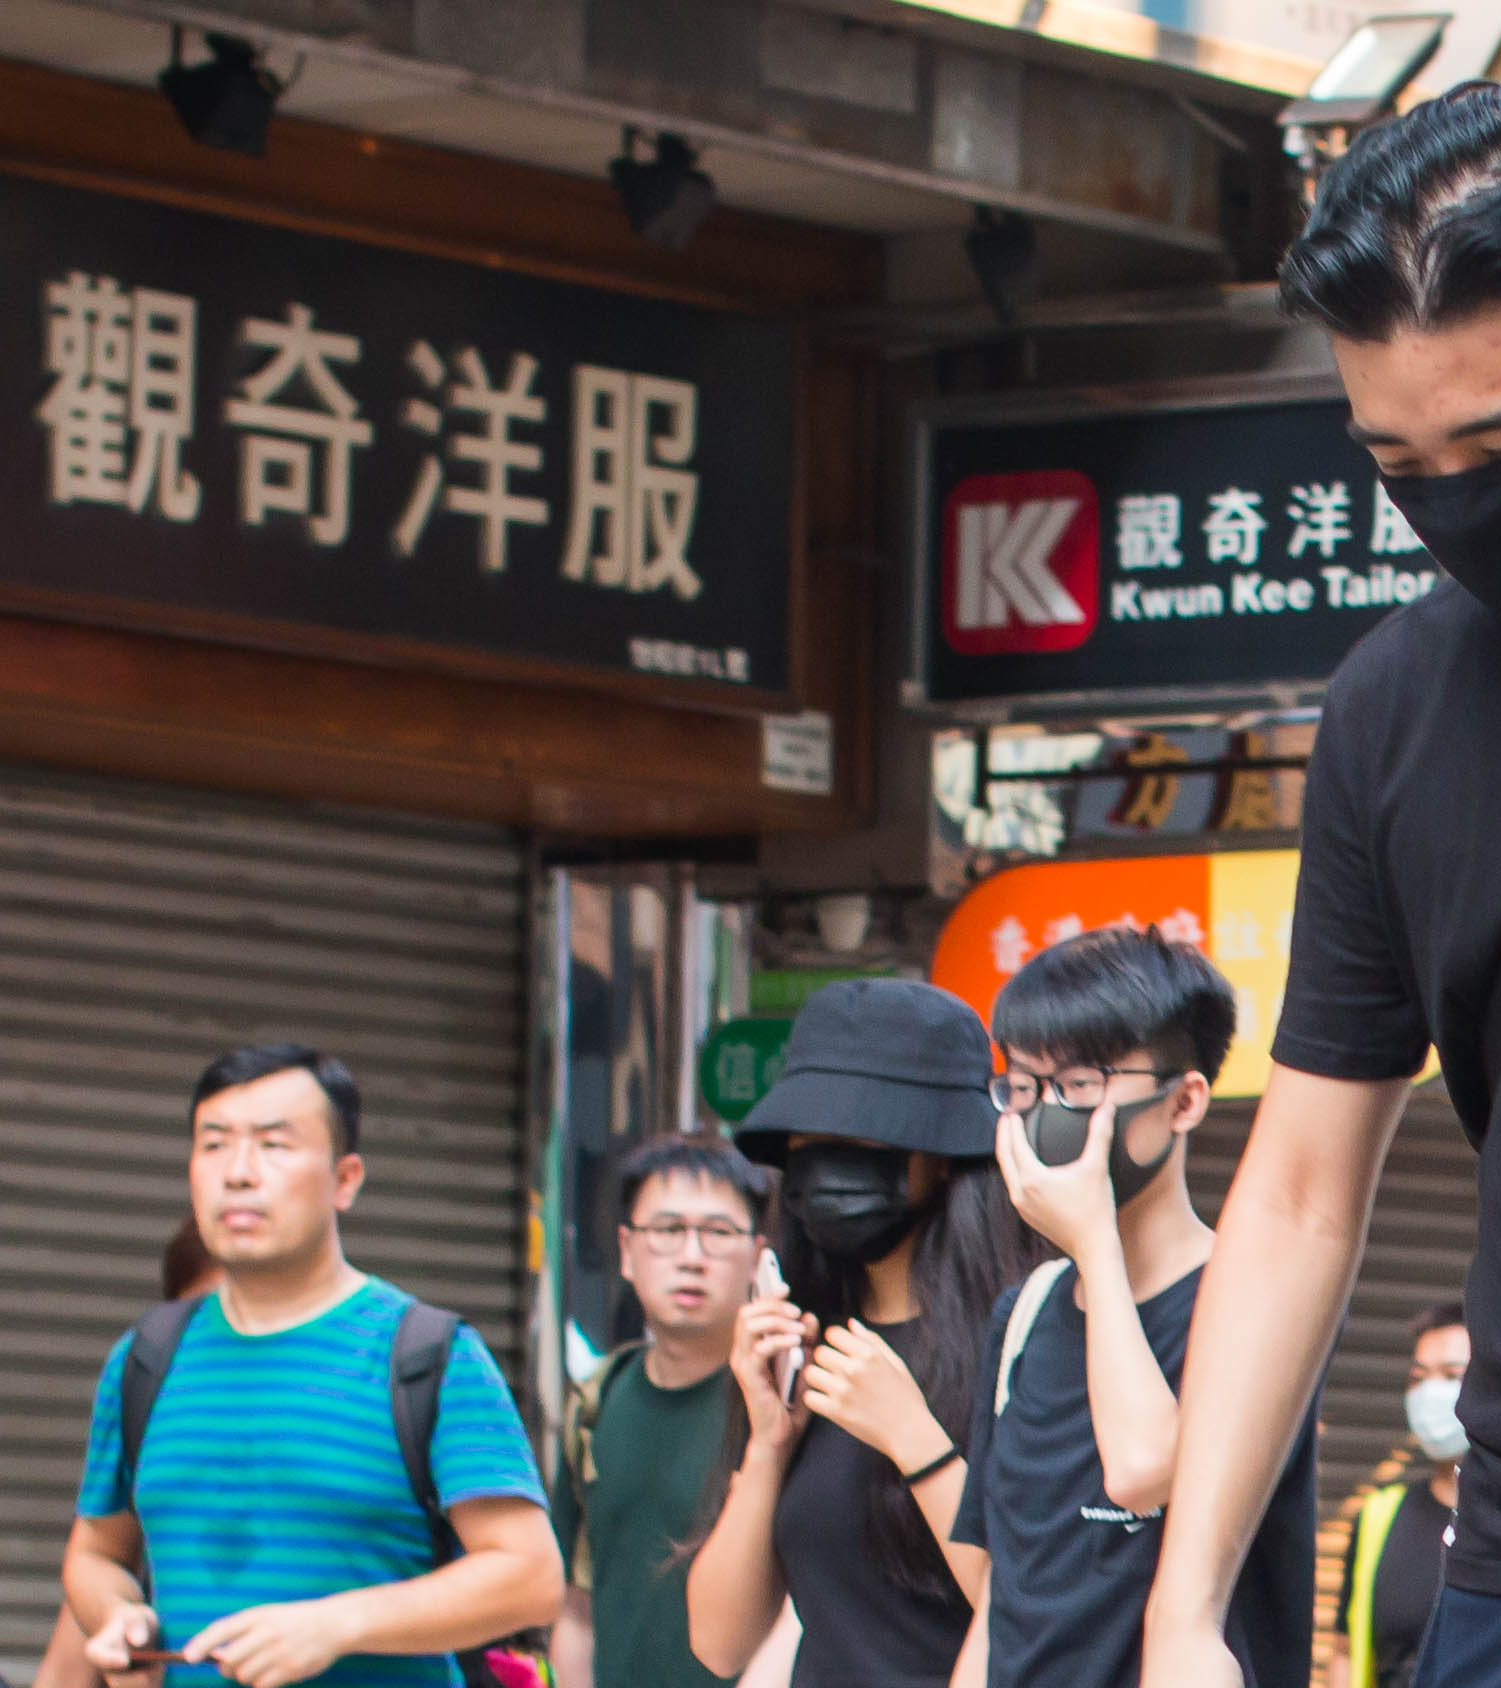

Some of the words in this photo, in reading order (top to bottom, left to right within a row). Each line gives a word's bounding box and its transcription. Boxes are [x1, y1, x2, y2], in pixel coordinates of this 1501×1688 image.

[35, 269, 702, 601] 觀奇洋服
[1111, 580, 1223, 622] Kwun
[1231, 573, 1313, 614] Kee
